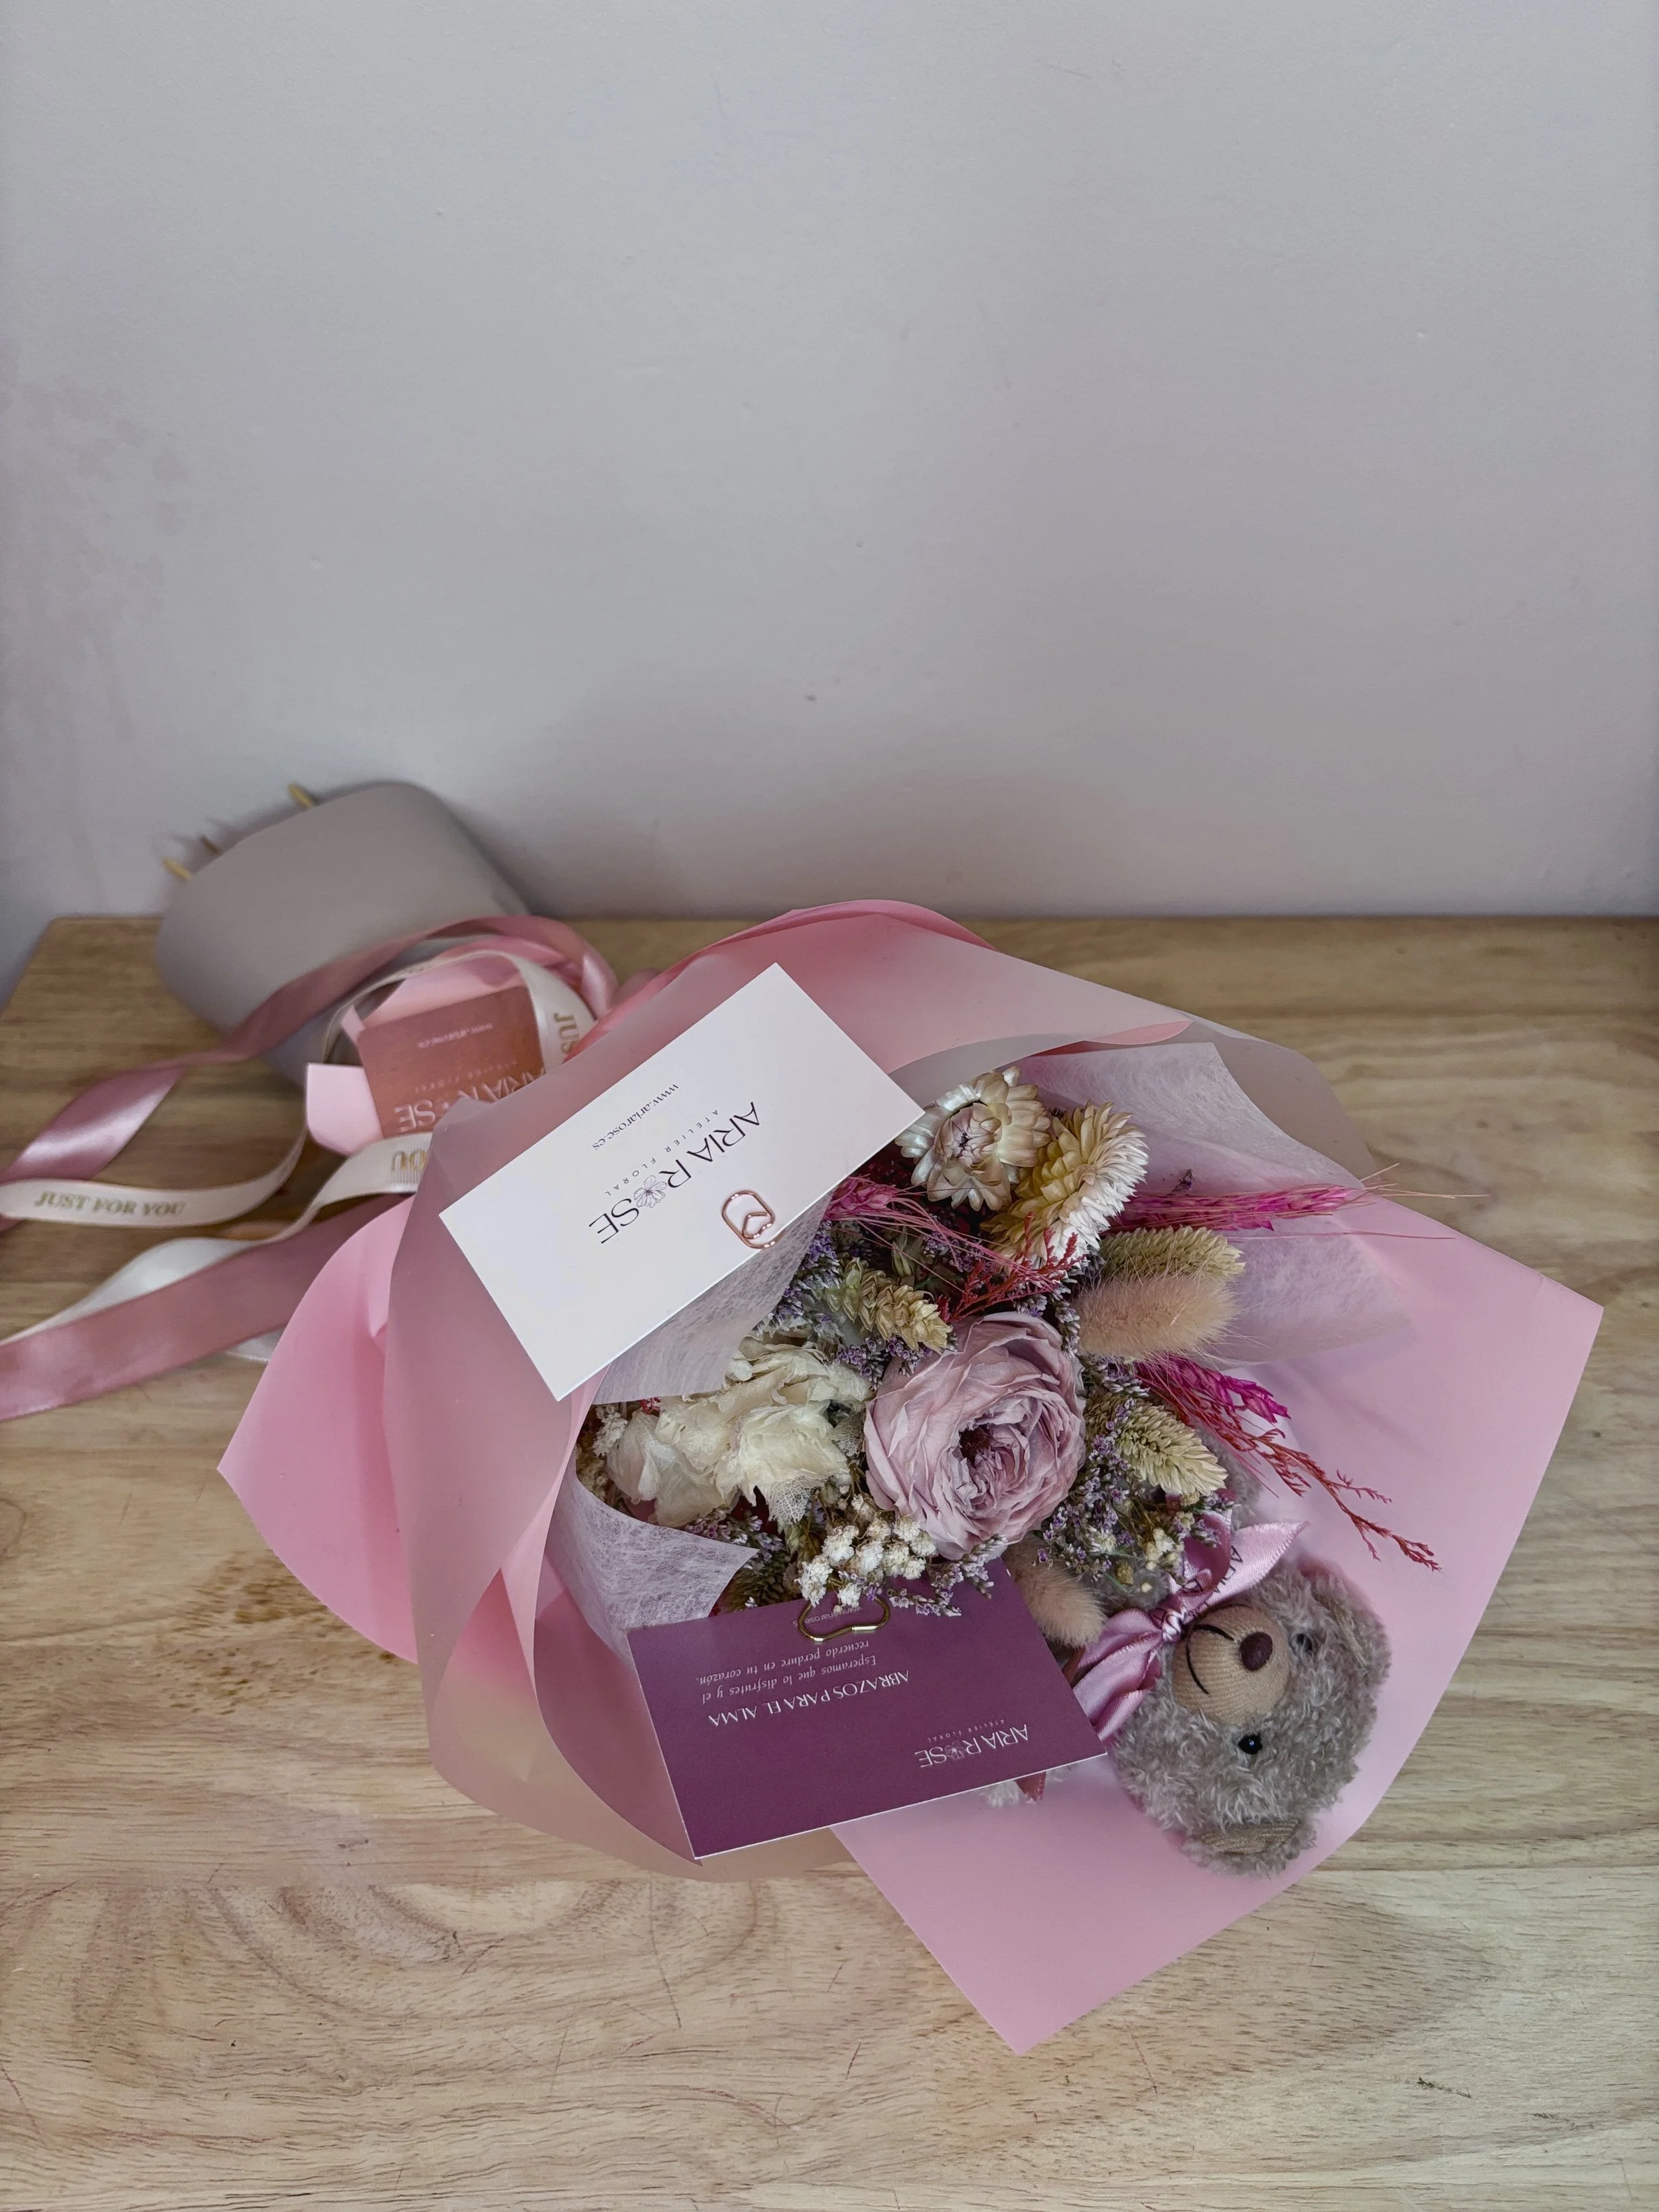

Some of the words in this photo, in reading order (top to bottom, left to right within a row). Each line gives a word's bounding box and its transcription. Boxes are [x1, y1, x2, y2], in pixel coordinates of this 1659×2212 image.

[593, 1083, 680, 1150] www.ariarose.es
[664, 1109, 719, 1153] ATELIER
[686, 1102, 760, 1162] ARIA
[605, 1157, 656, 1197] FLORAL
[35, 1191, 91, 1211] JUST
[92, 1197, 137, 1215] FOR
[143, 1201, 186, 1217] YOU
[780, 1647, 821, 1668] perdure
[826, 1640, 869, 1658] recuerdo
[747, 1665, 758, 1675] tu
[763, 1661, 776, 1671] en
[797, 1665, 816, 1680] que
[820, 1653, 876, 1674] Esperamos
[695, 1668, 742, 1686] corazón.
[782, 1674, 792, 1686] lo
[832, 1669, 910, 1699] ABRAZOS
[717, 1684, 724, 1699] y
[729, 1678, 778, 1697] disfrutes
[702, 1692, 711, 1704] el
[763, 1700, 781, 1715] EL
[783, 1689, 830, 1710] PARA
[708, 1706, 757, 1726] ALMA
[967, 1718, 1005, 1733] ATELIER
[926, 1730, 962, 1743] FLORAL
[980, 1724, 1029, 1750] ARIA
